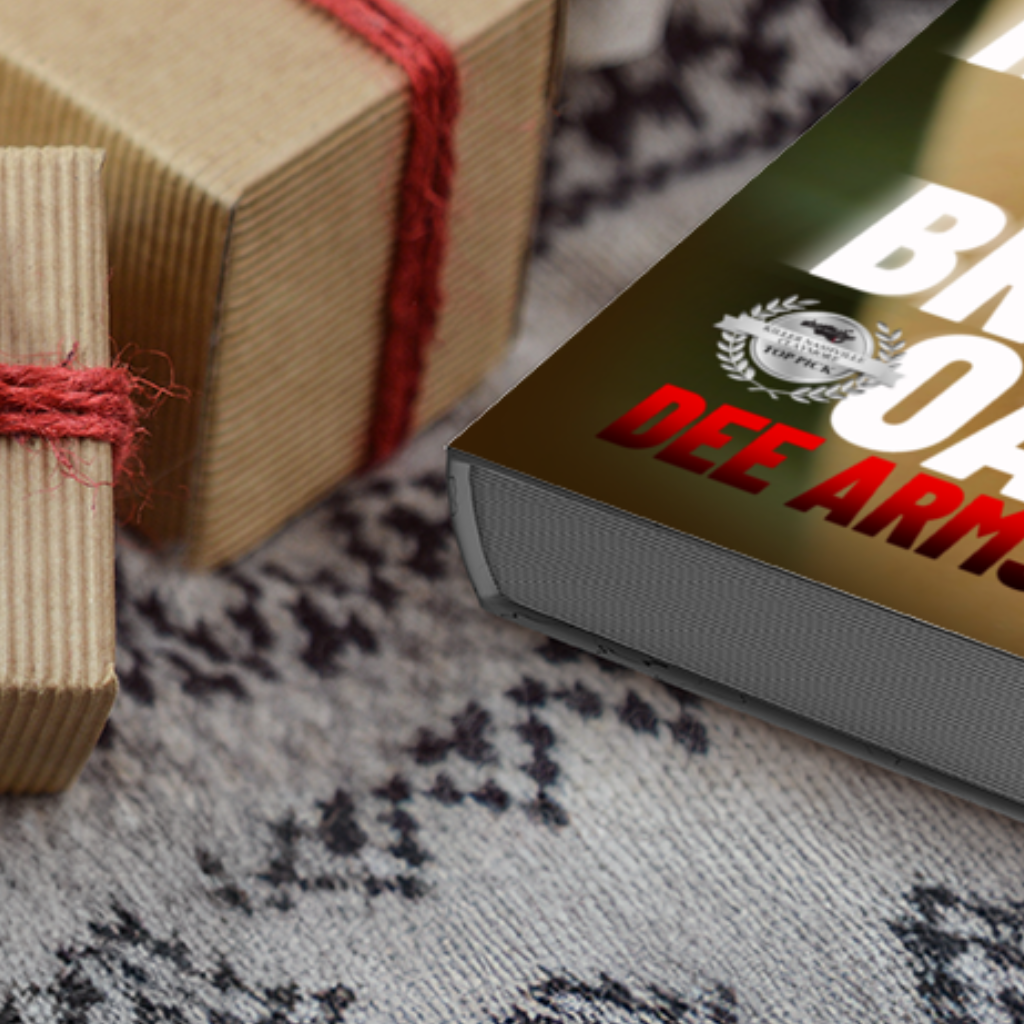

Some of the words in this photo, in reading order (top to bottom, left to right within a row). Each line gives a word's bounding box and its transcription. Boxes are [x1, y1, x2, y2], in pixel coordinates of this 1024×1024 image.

[763, 345, 796, 364] TOP
[795, 355, 836, 375] PICK
[595, 382, 827, 495] DEE
